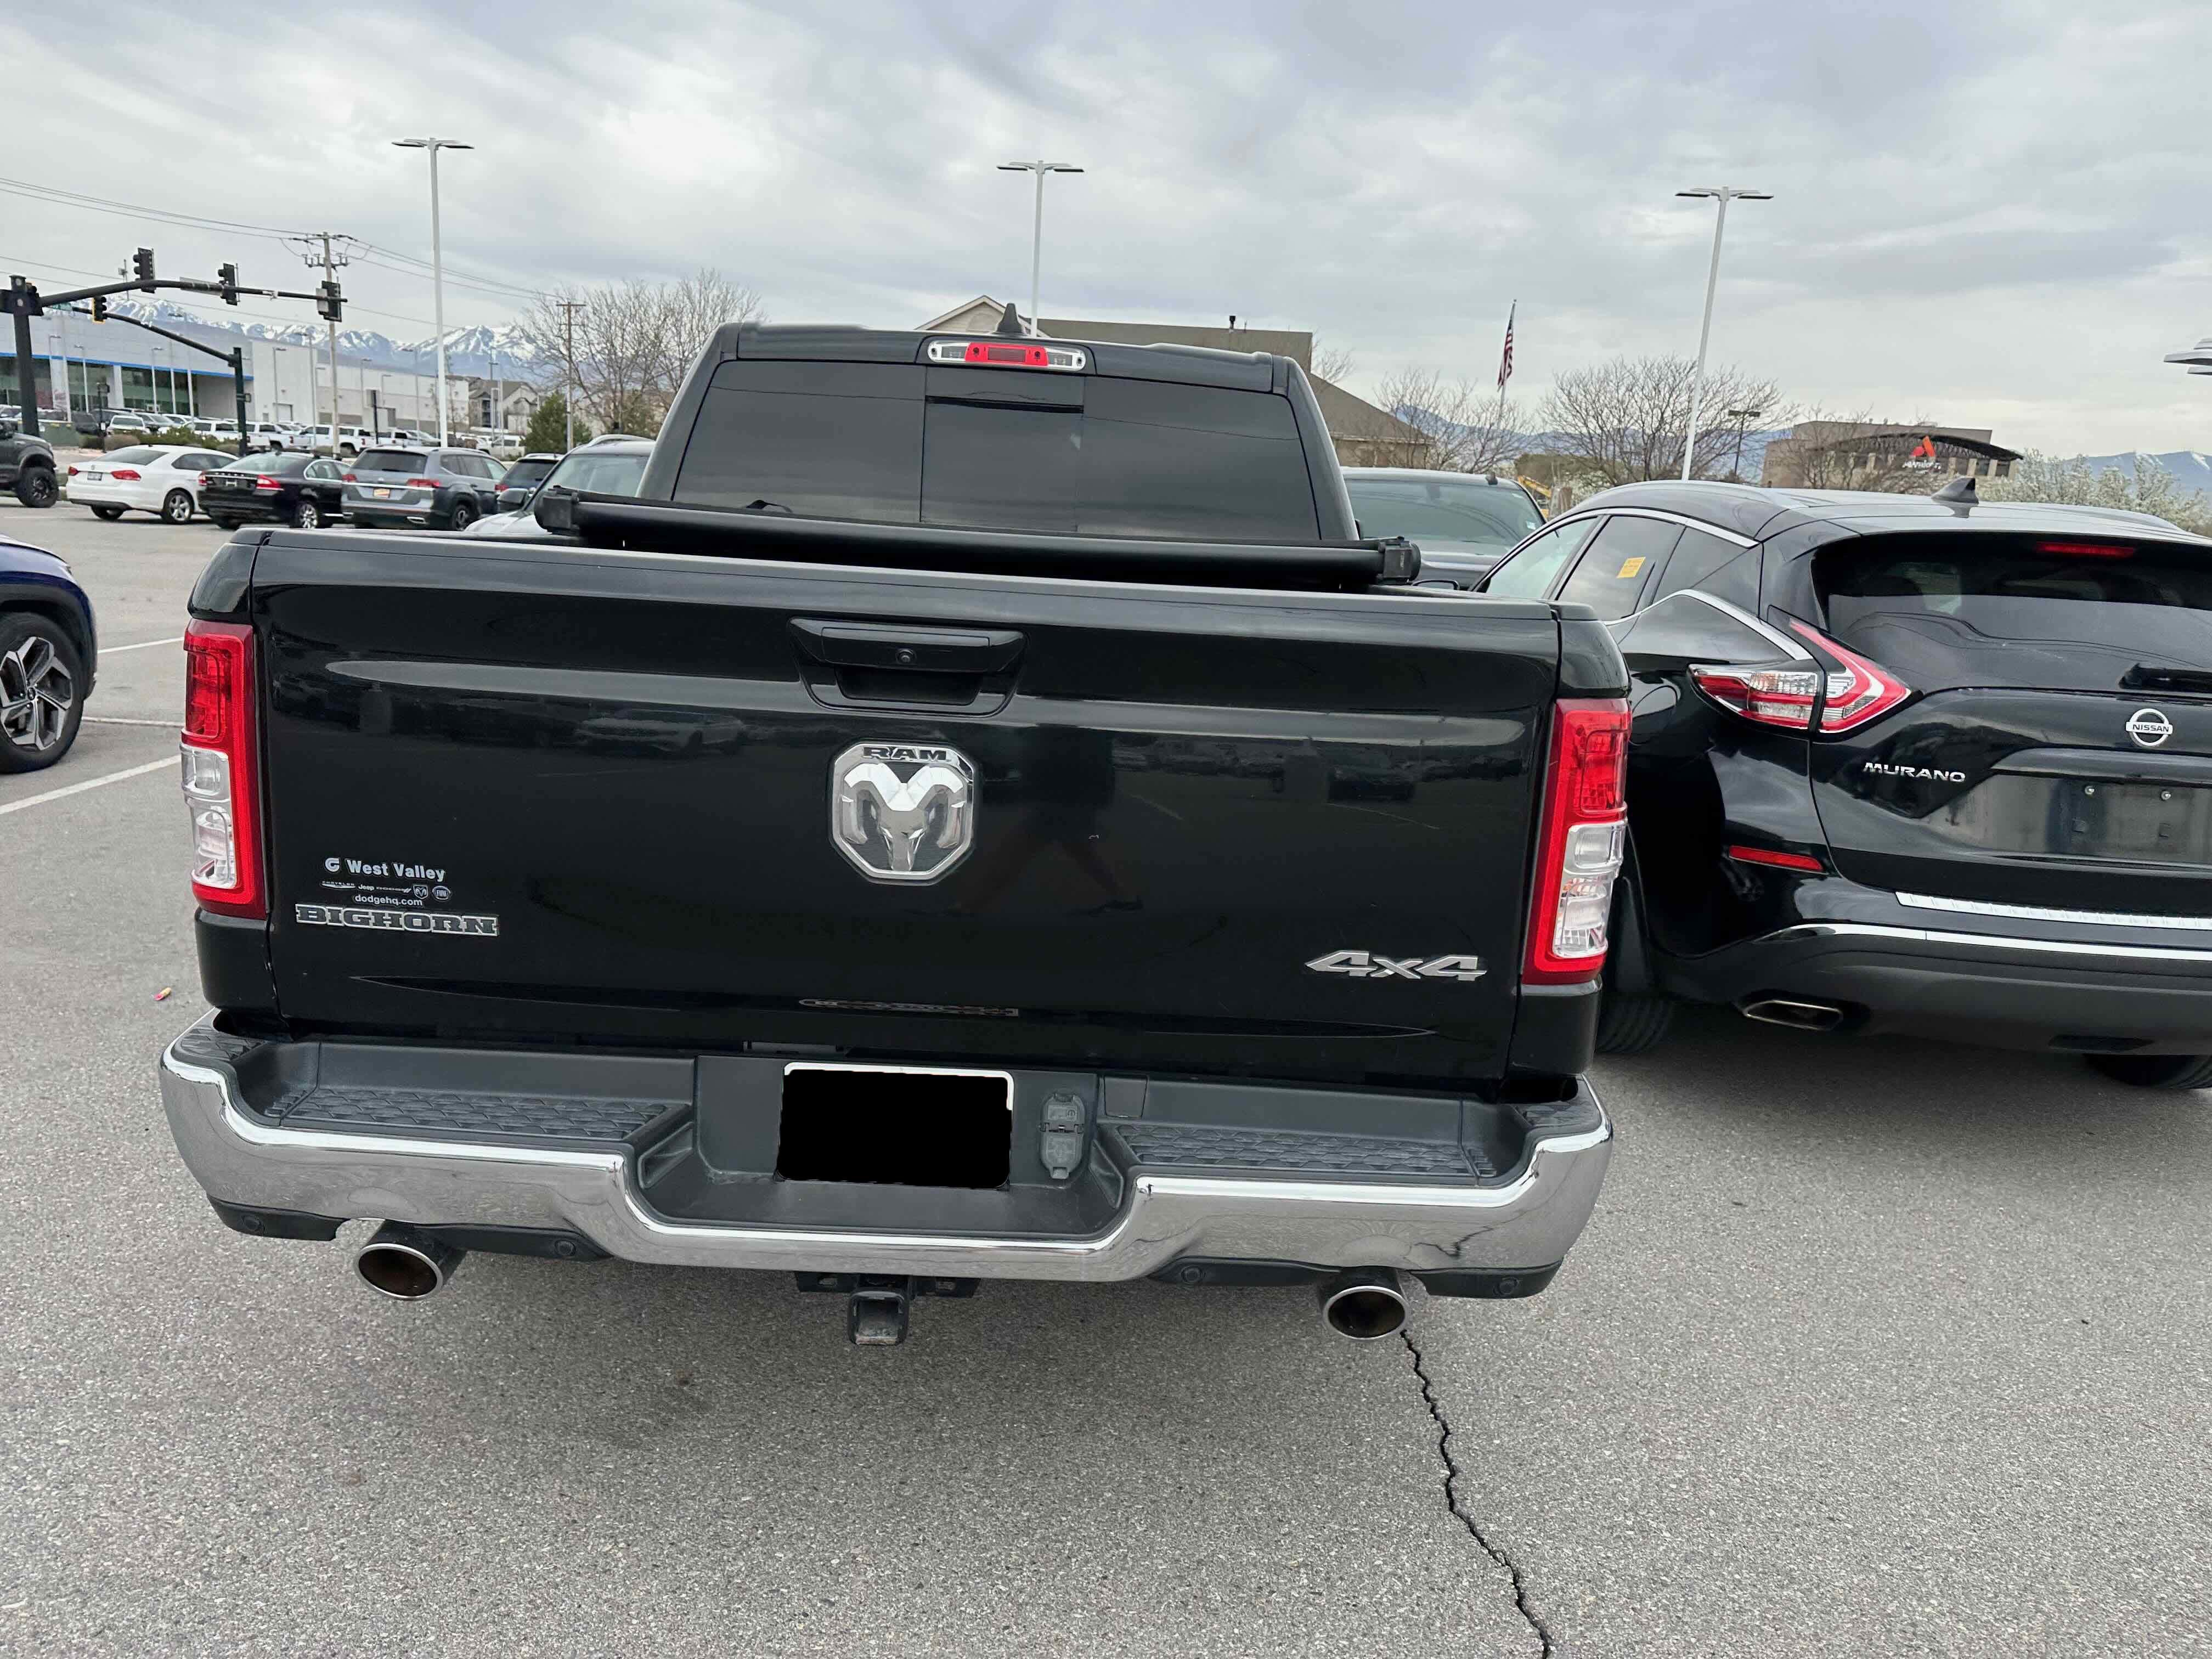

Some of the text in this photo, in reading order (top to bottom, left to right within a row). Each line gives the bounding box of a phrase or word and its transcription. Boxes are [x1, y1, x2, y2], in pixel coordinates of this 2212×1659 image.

[2132, 724, 2170, 732] NISSAN
[863, 746, 947, 761] RAM
[1863, 762, 1966, 783] MURANO
[345, 859, 388, 876] West
[393, 863, 445, 882] Valley
[355, 894, 422, 906] dodgehq.com
[295, 904, 500, 936] BIGHORN
[1304, 950, 1487, 981] 4x4
